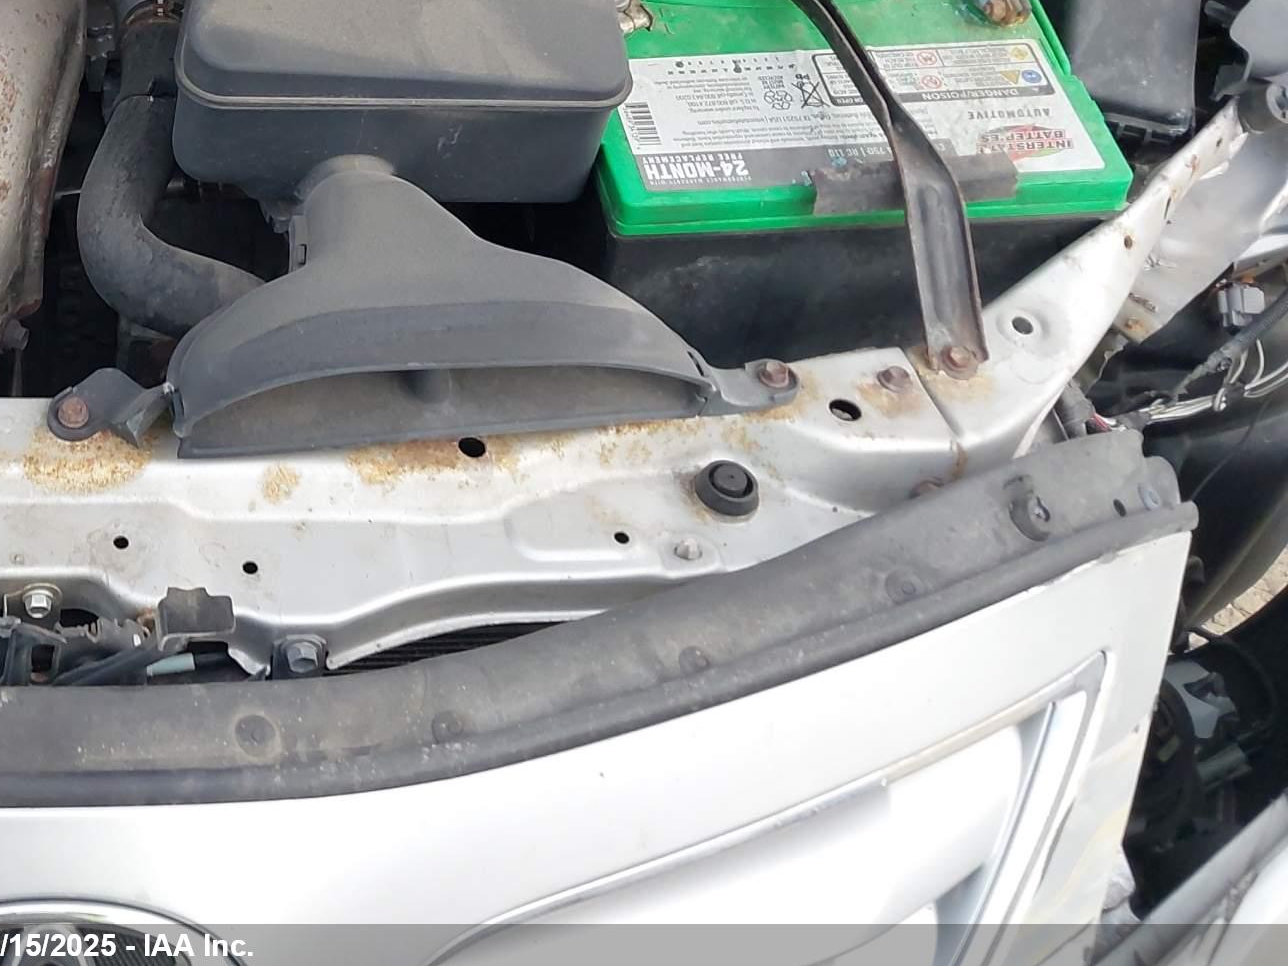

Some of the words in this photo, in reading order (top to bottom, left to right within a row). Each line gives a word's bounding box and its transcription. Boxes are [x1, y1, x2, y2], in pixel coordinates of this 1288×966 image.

[795, 73, 810, 81] Pb
[921, 88, 1019, 101] DANGER/POISON
[967, 108, 1051, 121] AUTOMOTIVE
[641, 153, 715, 165] REPLACEMENT
[717, 152, 744, 162] FREE
[642, 160, 750, 181] 24-MONTH
